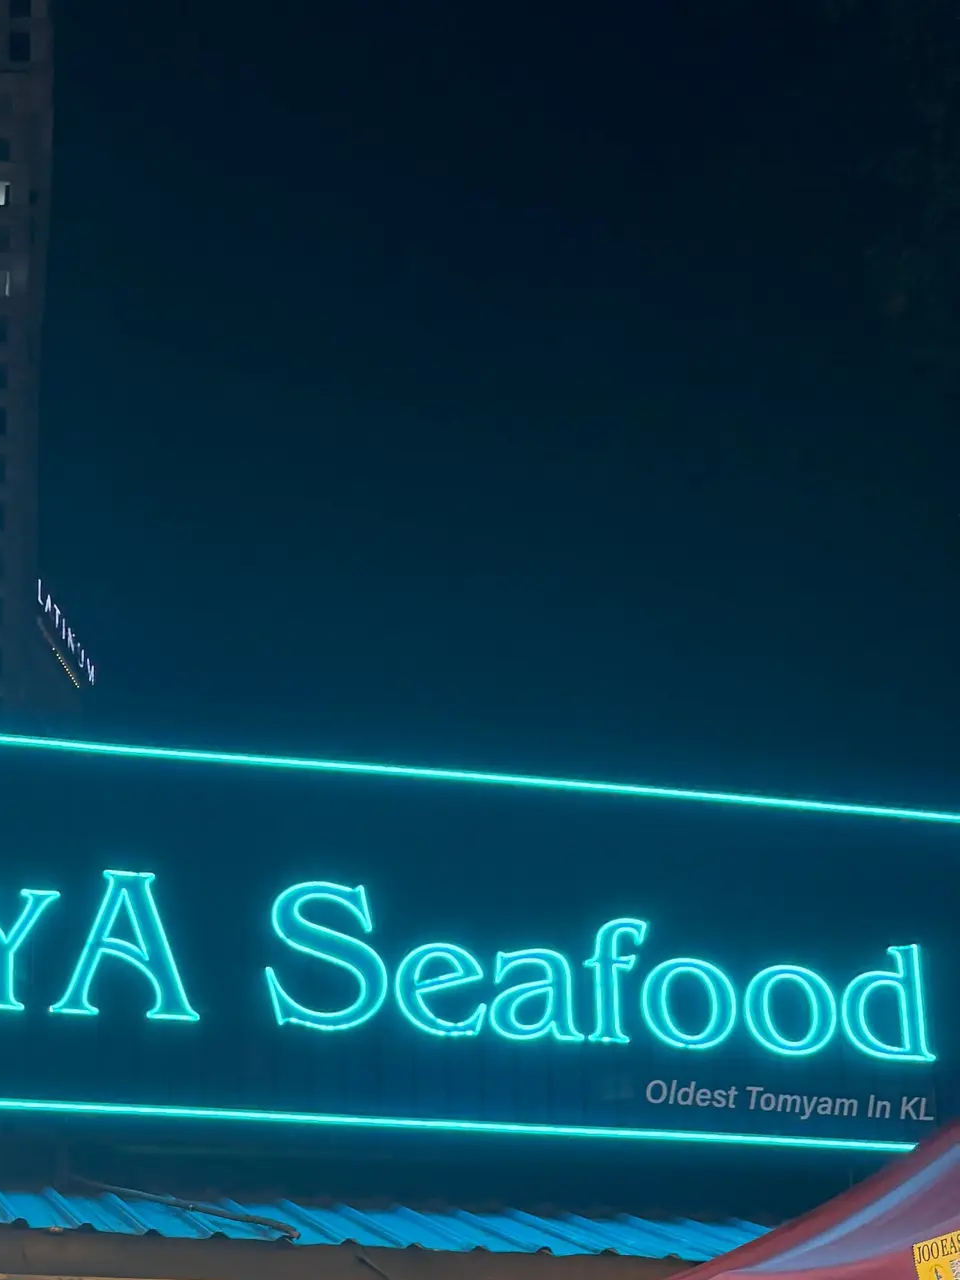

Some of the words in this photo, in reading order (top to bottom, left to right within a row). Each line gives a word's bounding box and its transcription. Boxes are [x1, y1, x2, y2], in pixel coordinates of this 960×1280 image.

[264, 880, 937, 1063] Seafood
[645, 1079, 738, 1109] Oldest
[745, 1086, 859, 1120] Tomyam
[867, 1094, 891, 1119] In
[900, 1096, 934, 1121] KL
